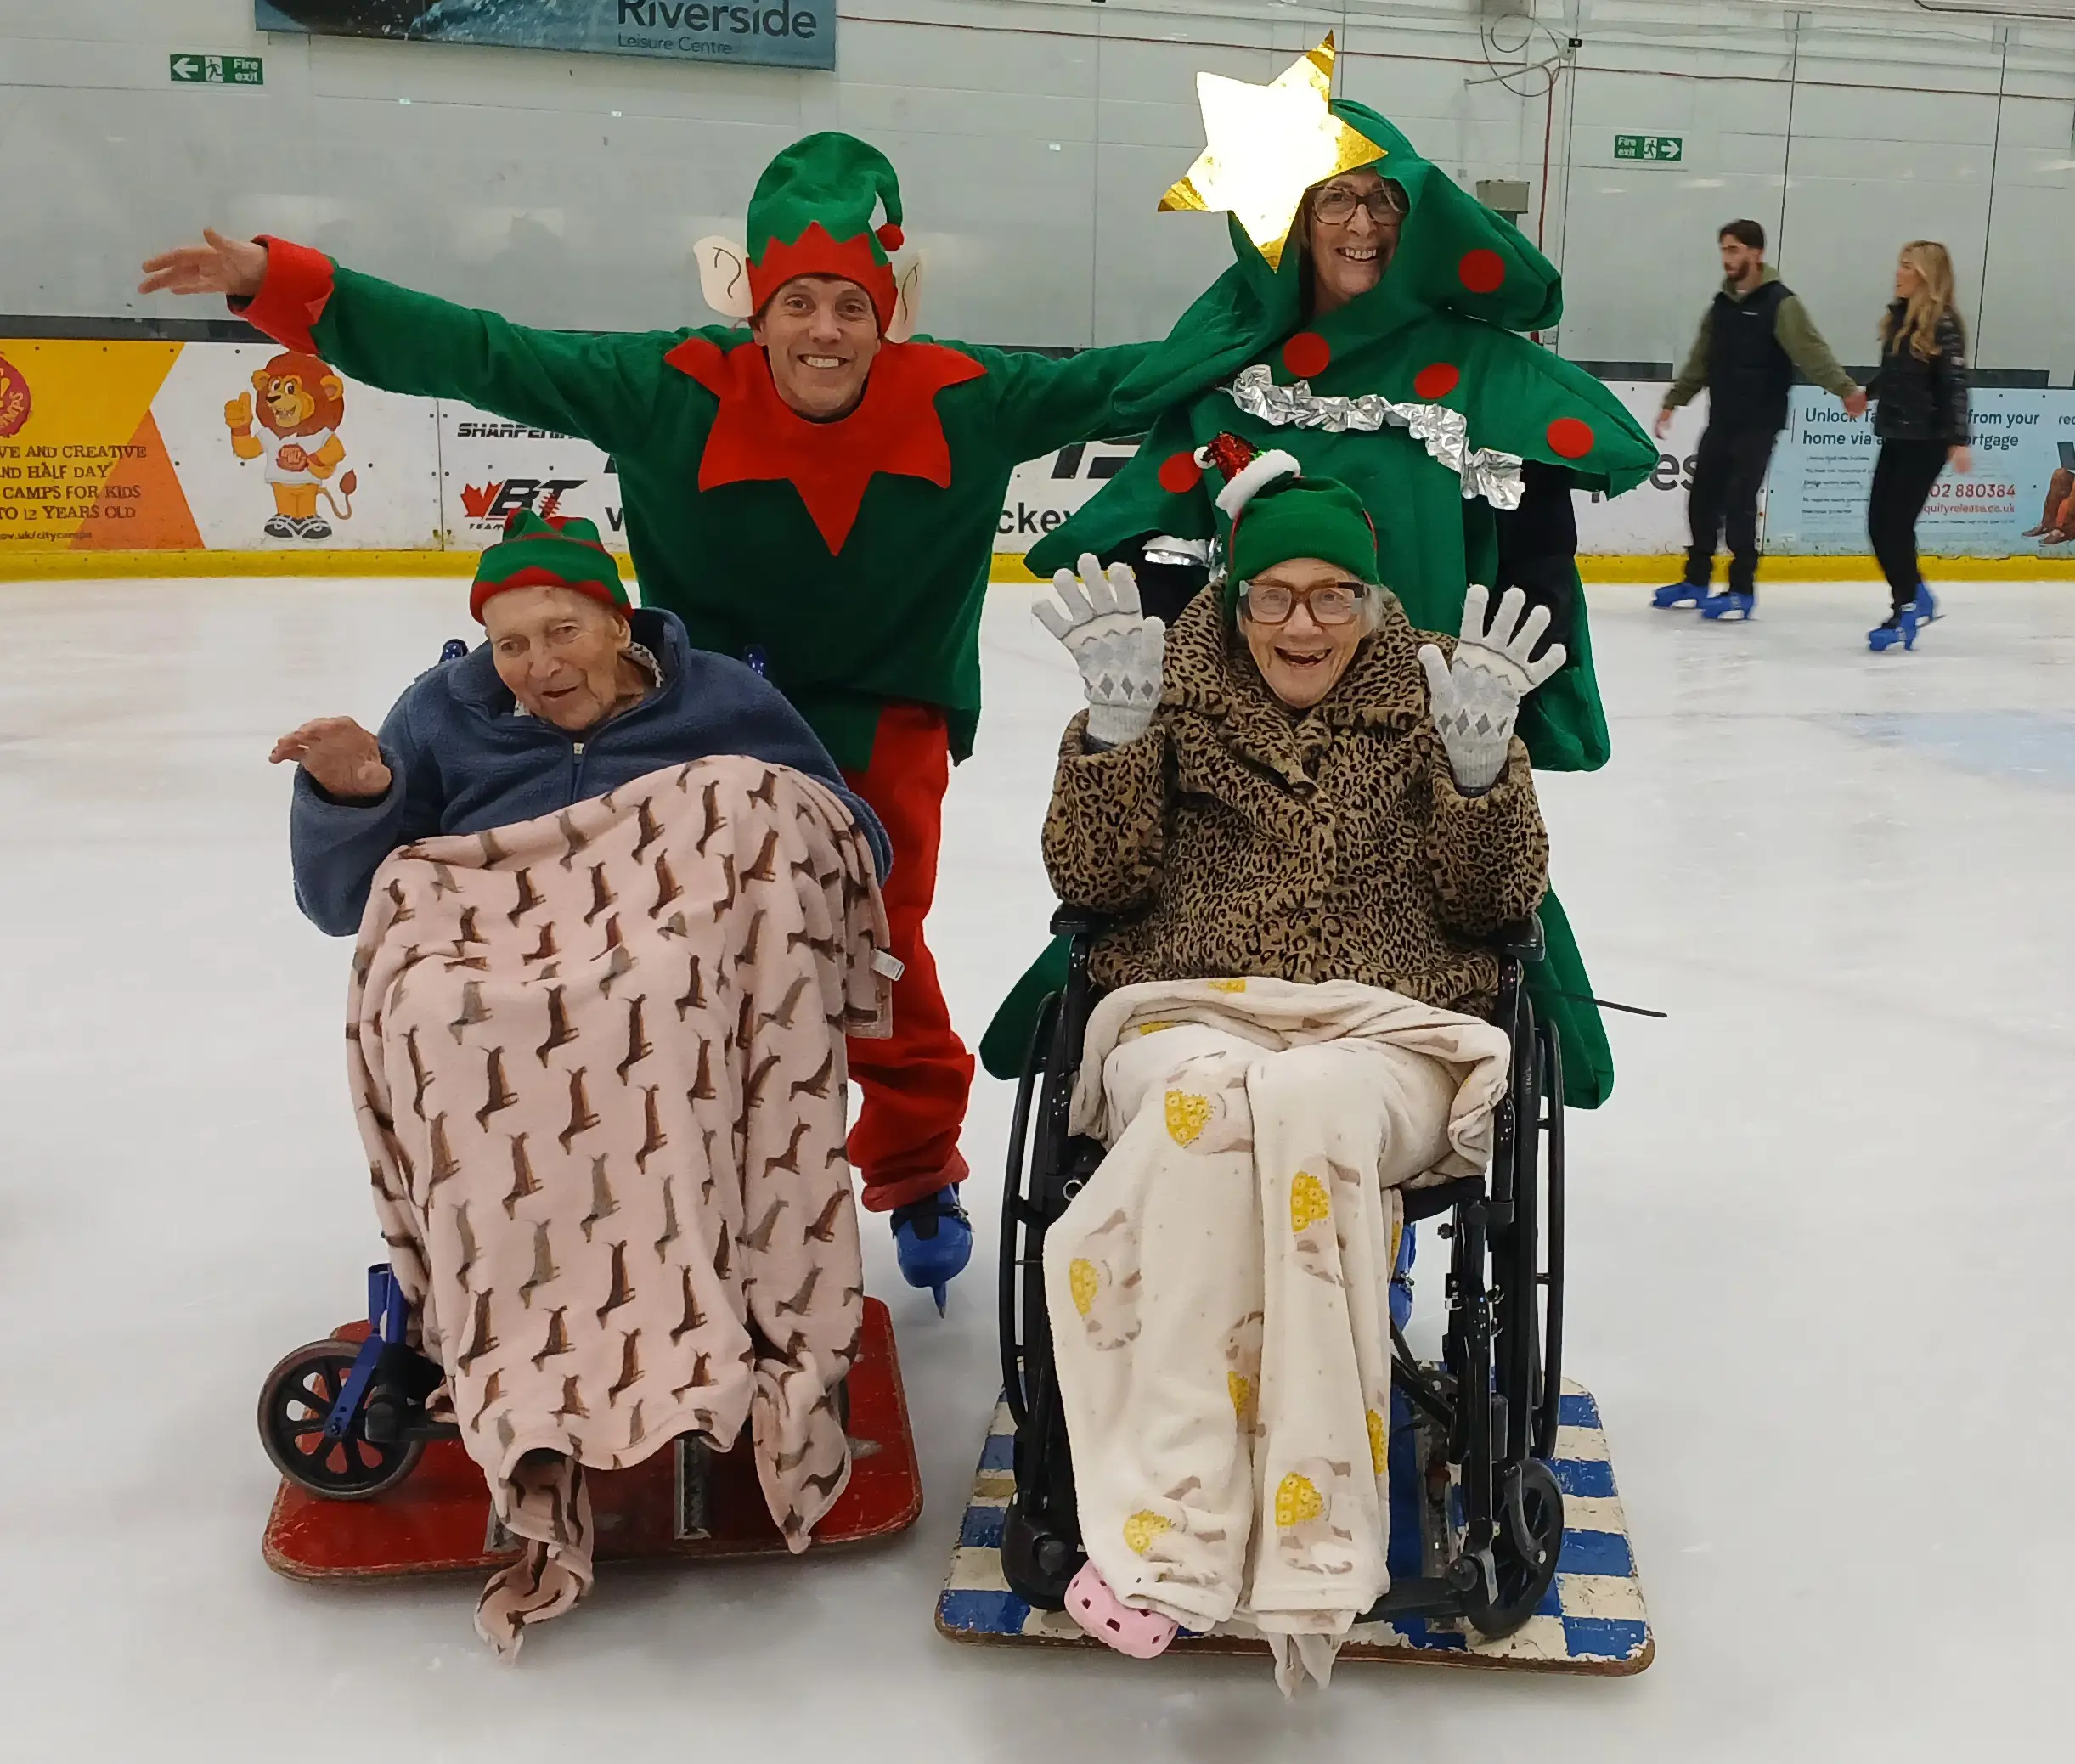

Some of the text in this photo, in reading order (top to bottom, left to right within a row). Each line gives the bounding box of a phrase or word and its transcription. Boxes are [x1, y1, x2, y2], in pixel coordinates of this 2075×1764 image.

[617, 0, 817, 38] Riverside
[617, 33, 733, 55] Leisure Centre
[234, 58, 259, 70] Fire
[235, 71, 258, 82] exit
[1617, 137, 1637, 147] Fire
[1617, 147, 1636, 157] exit
[1967, 409, 2002, 425] from
[2005, 414, 2040, 429] your
[1802, 430, 1846, 445] home
[1850, 430, 1872, 445] via
[25, 445, 58, 459] AND
[62, 445, 147, 459] CREATIVE
[0, 465, 110, 480] ND HALF DAY
[3, 484, 142, 499] CAMPS FOR KIDS
[1955, 483, 2016, 499] 880384
[42, 505, 100, 519] YEARS
[104, 506, 137, 519] OLD
[1923, 503, 2016, 516] quityrelease.co.uk
